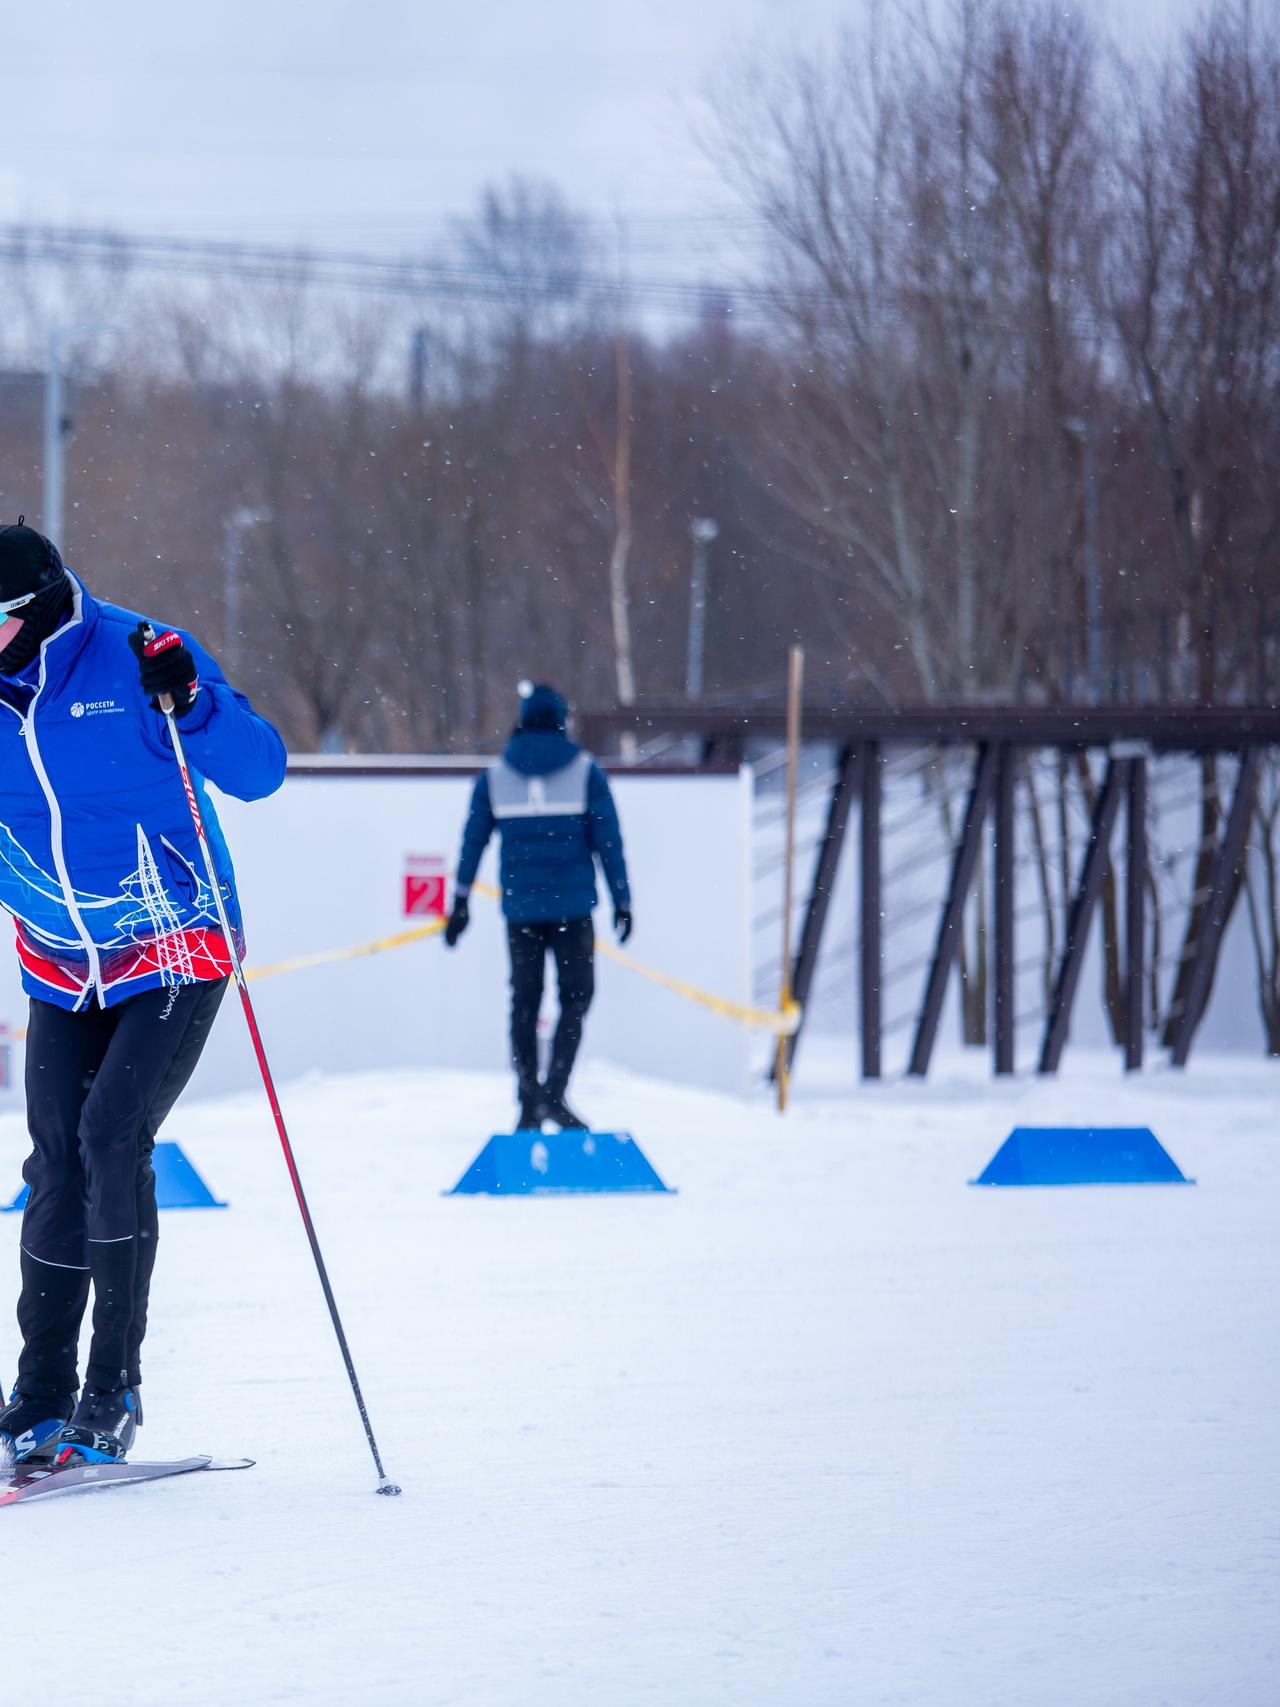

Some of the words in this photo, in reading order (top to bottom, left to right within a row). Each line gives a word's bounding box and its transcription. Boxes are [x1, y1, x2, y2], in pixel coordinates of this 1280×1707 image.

[153, 639, 166, 651] SKI
[86, 700, 115, 710] РОССЕТИ
[410, 877, 441, 914] 2
